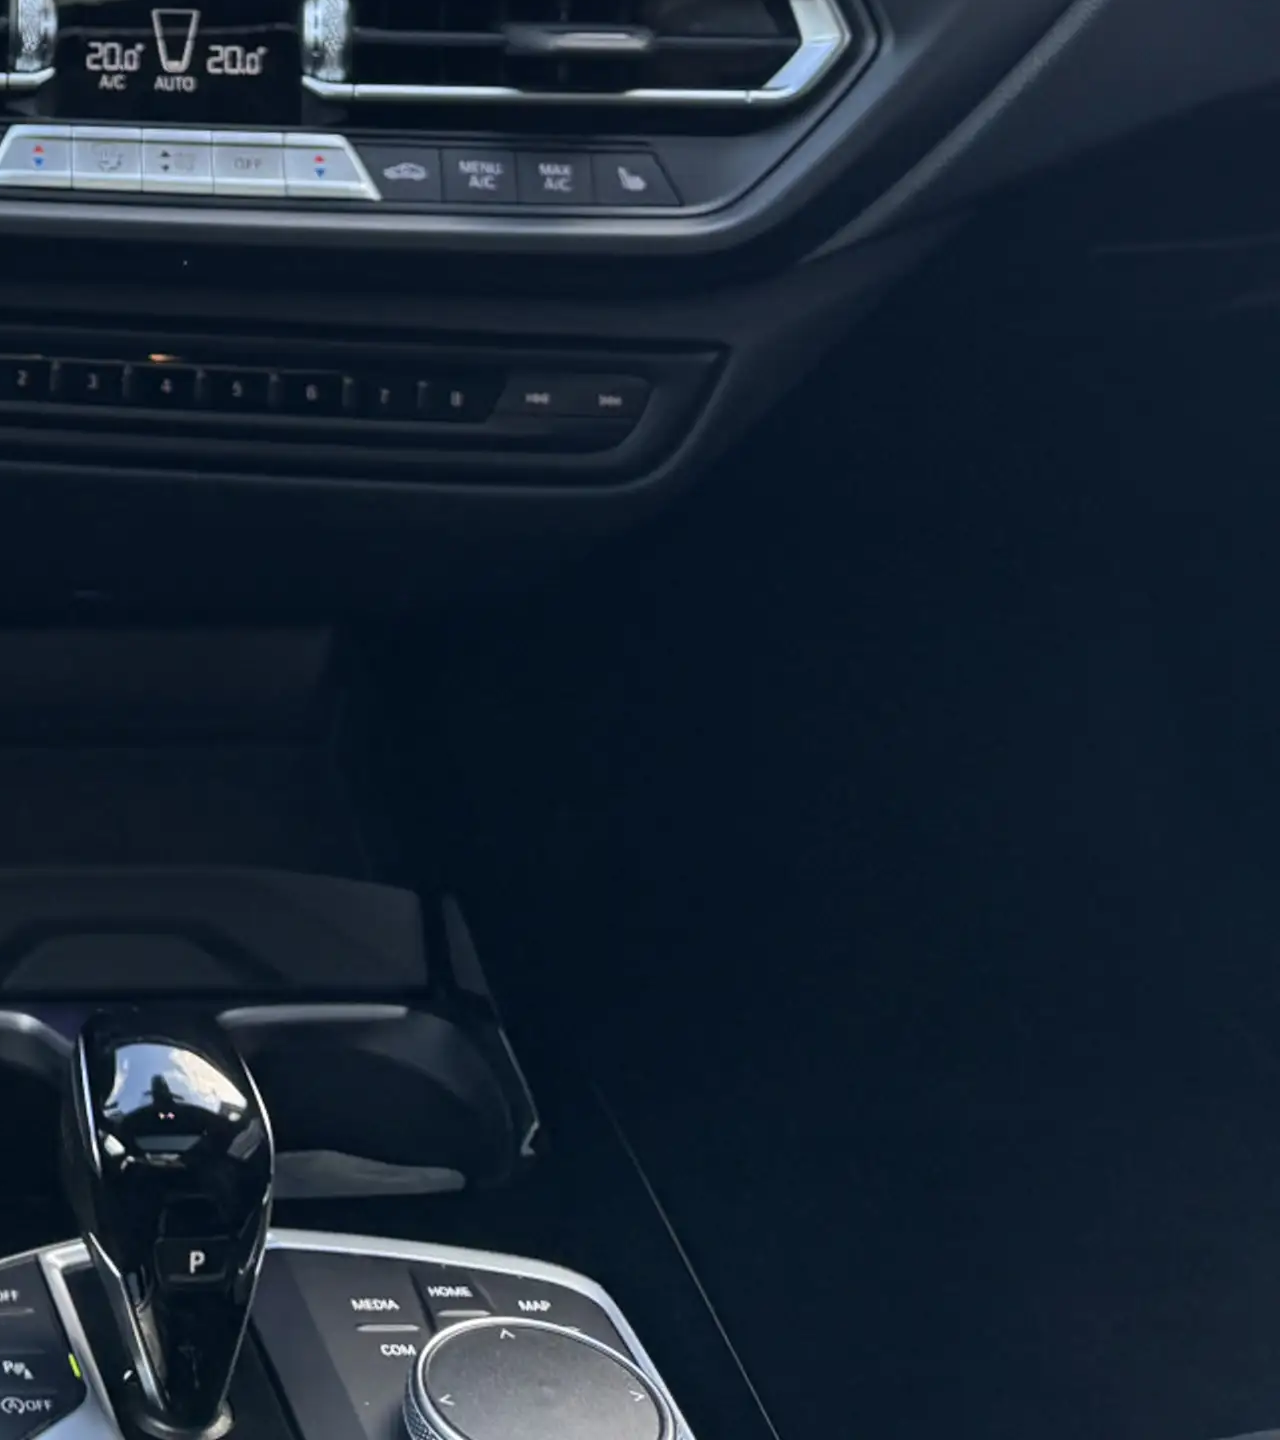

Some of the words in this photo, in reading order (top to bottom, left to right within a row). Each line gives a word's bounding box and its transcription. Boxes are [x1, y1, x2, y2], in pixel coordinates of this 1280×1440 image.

[98, 75, 127, 90] A/C
[153, 76, 198, 92] AUTO
[539, 162, 572, 177] MAX
[469, 175, 497, 190] A/C
[543, 176, 573, 192] A/C
[188, 1251, 206, 1274] P
[427, 1285, 474, 1298] HOME
[351, 1299, 401, 1312] MEDIA
[517, 1300, 552, 1313] MAP
[379, 1343, 417, 1357] COM
[25, 1398, 53, 1412] OFF
